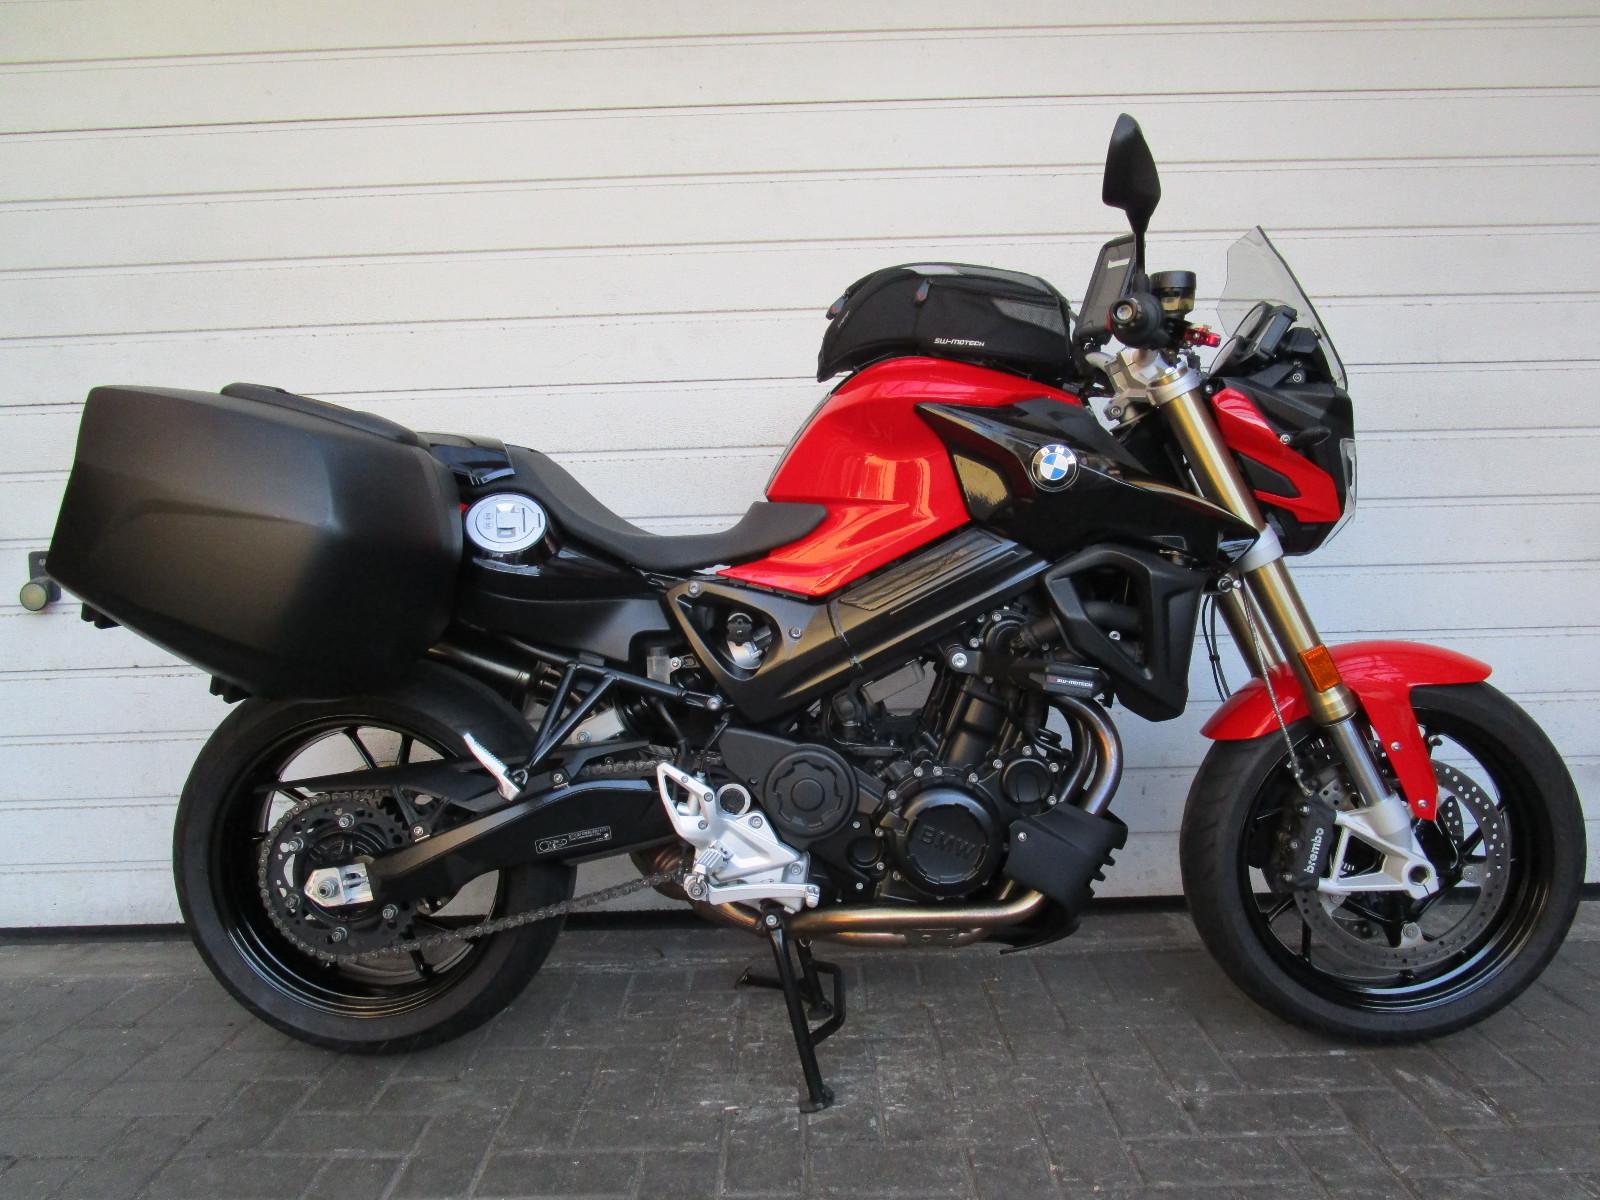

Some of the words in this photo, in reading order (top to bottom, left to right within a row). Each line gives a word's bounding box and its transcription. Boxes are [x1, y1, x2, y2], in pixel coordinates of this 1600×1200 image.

[933, 337, 985, 347] SW-MOTECH
[1040, 445, 1077, 464] BMW
[920, 824, 976, 859] BMW
[1304, 827, 1325, 874] brembo
